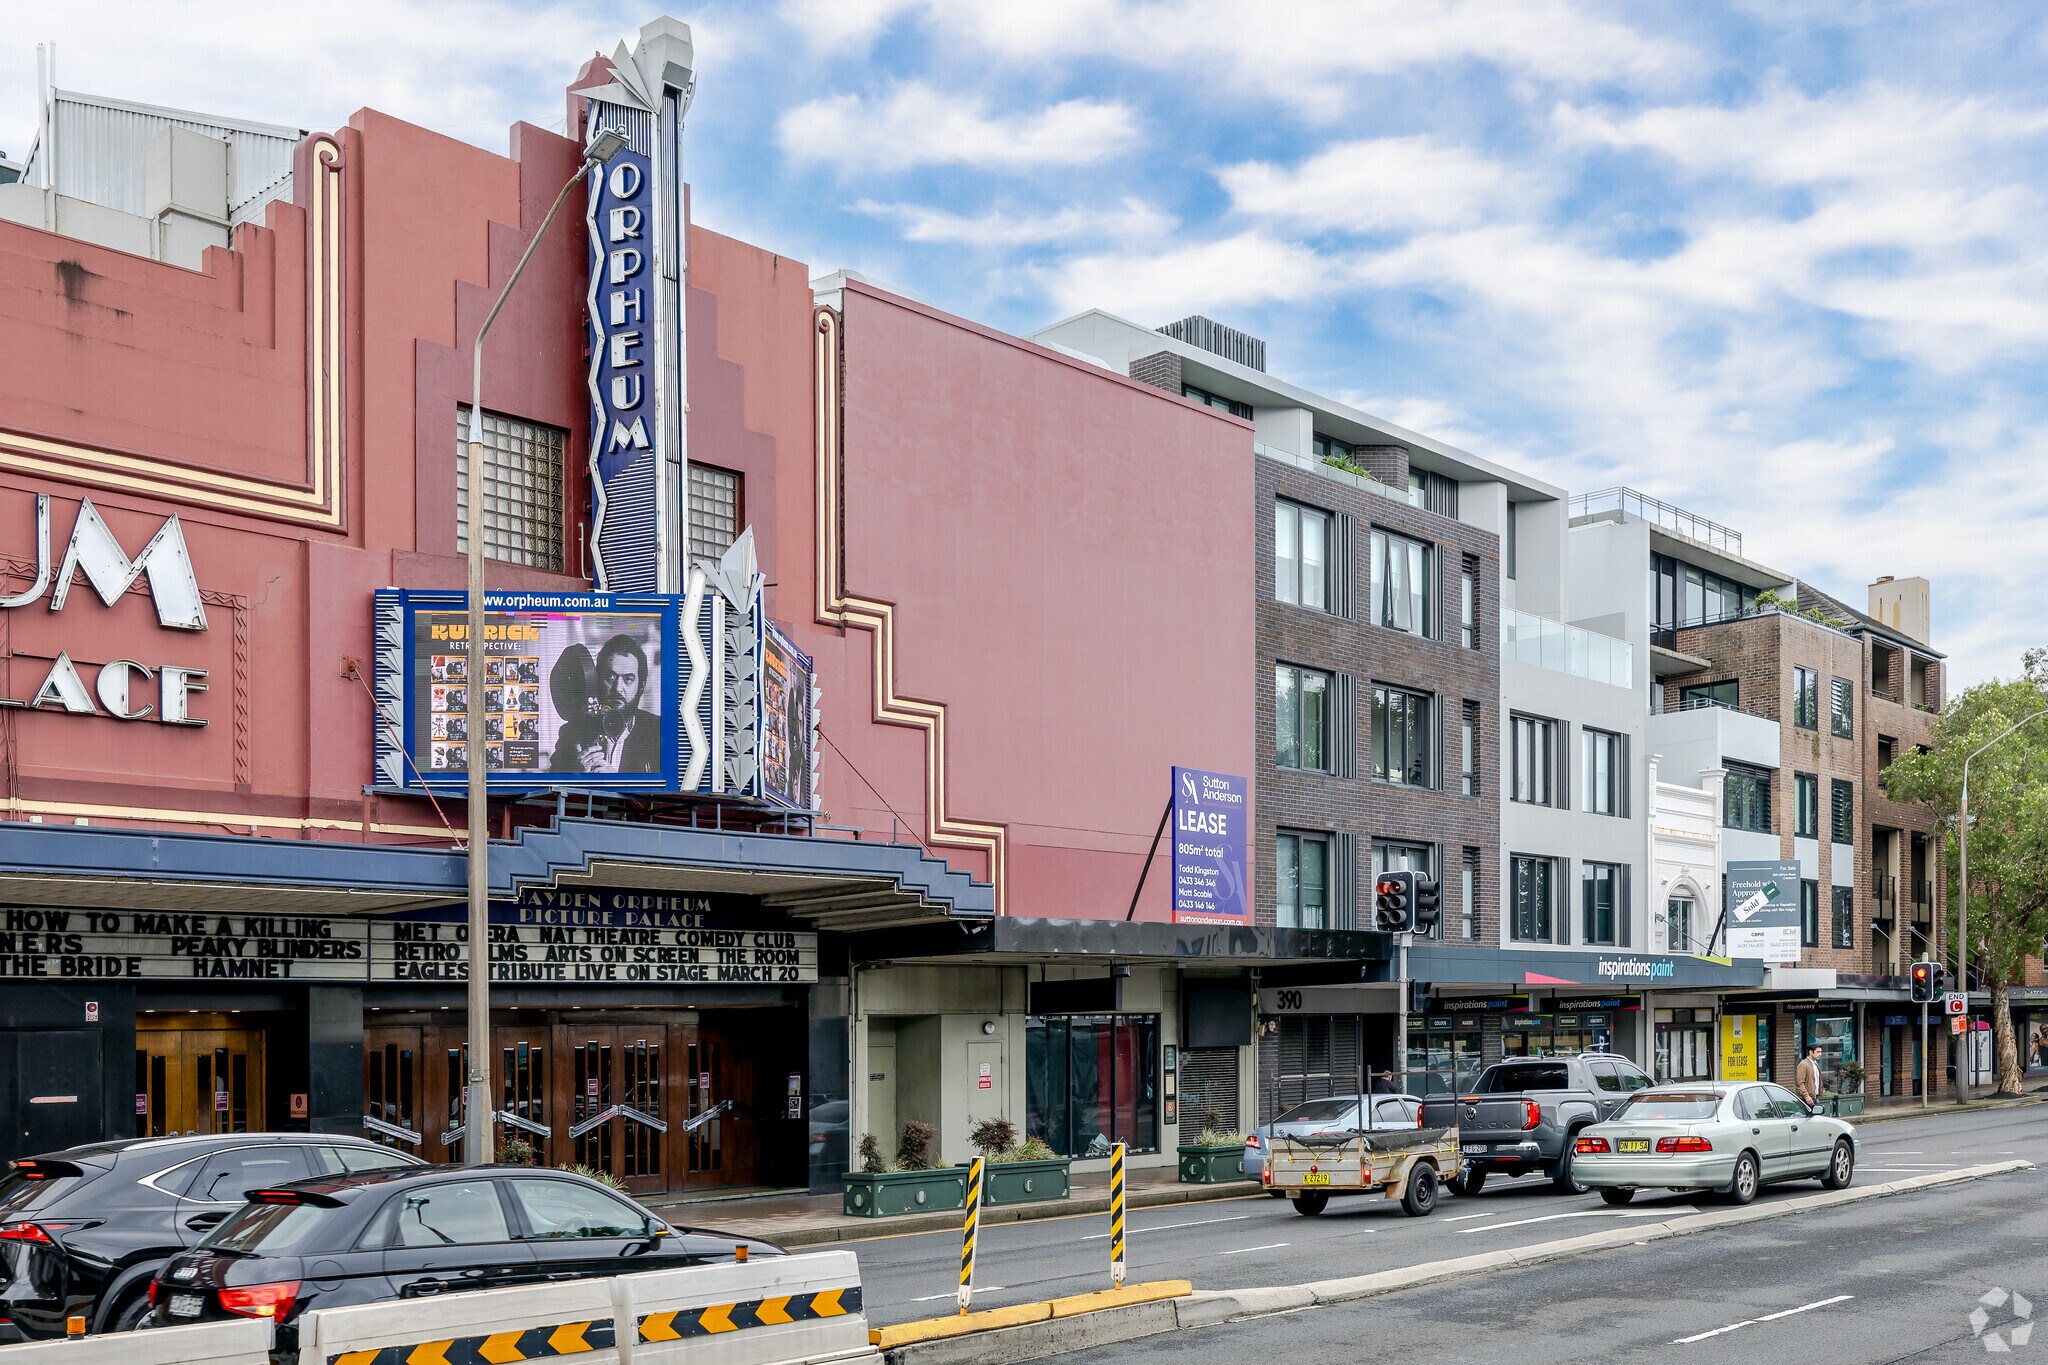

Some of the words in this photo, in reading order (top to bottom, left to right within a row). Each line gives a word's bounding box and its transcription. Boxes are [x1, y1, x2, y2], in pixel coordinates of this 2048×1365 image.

[607, 162, 652, 454] ORPHEUM
[483, 594, 609, 609] ww.orpheum.com.au
[0, 651, 209, 726] ACE
[1202, 775, 1229, 790] Sutton
[1202, 787, 1242, 804] Anderson
[1179, 808, 1227, 836] LEASE
[1205, 846, 1224, 858] total
[1178, 864, 1193, 873] Todd
[1194, 865, 1219, 876] Kingston
[1178, 876, 1193, 885] 0433
[1731, 880, 1760, 888] Freehold
[1178, 888, 1193, 897] Matt
[1193, 889, 1213, 898] Scobie
[612, 894, 711, 912] ORPHEUM
[1178, 900, 1193, 908] 0433
[1742, 899, 1760, 914] Sold
[6, 910, 70, 932] HOW
[86, 912, 120, 933] TO
[133, 914, 206, 935] MAKE
[215, 916, 233, 936] A
[245, 917, 332, 938] KILLING
[520, 908, 613, 925] PICTURE
[625, 911, 704, 927] PALACE
[394, 922, 441, 942] MET
[540, 926, 576, 944] NAT
[584, 927, 661, 945] THEATRE
[675, 930, 745, 947] COMEDY
[753, 932, 796, 948] CLUB
[171, 936, 248, 957] PEAKY
[257, 938, 362, 960] BLINDERS
[394, 942, 460, 961] RETRO
[545, 945, 592, 962] ARTS
[600, 946, 626, 963] ON
[633, 946, 699, 963] SCREEN
[716, 949, 747, 964] THE
[754, 949, 799, 965] ROOM
[0, 955, 48, 976] THE
[60, 956, 142, 977] BRIDE
[193, 957, 294, 978] HAMNET
[394, 961, 468, 980] EAGLES
[488, 963, 566, 980] TRIBUTE
[575, 964, 616, 980] LIVE
[626, 964, 650, 981] ON
[656, 965, 709, 981] STAGE
[717, 965, 772, 981] MARCH
[778, 966, 799, 981] 20
[1277, 990, 1302, 1010] 390
[1952, 1001, 1960, 1012] C
[1732, 1043, 1743, 1054] SHOP
[1727, 1056, 1735, 1067] FOR
[1736, 1055, 1748, 1067] LEASE
